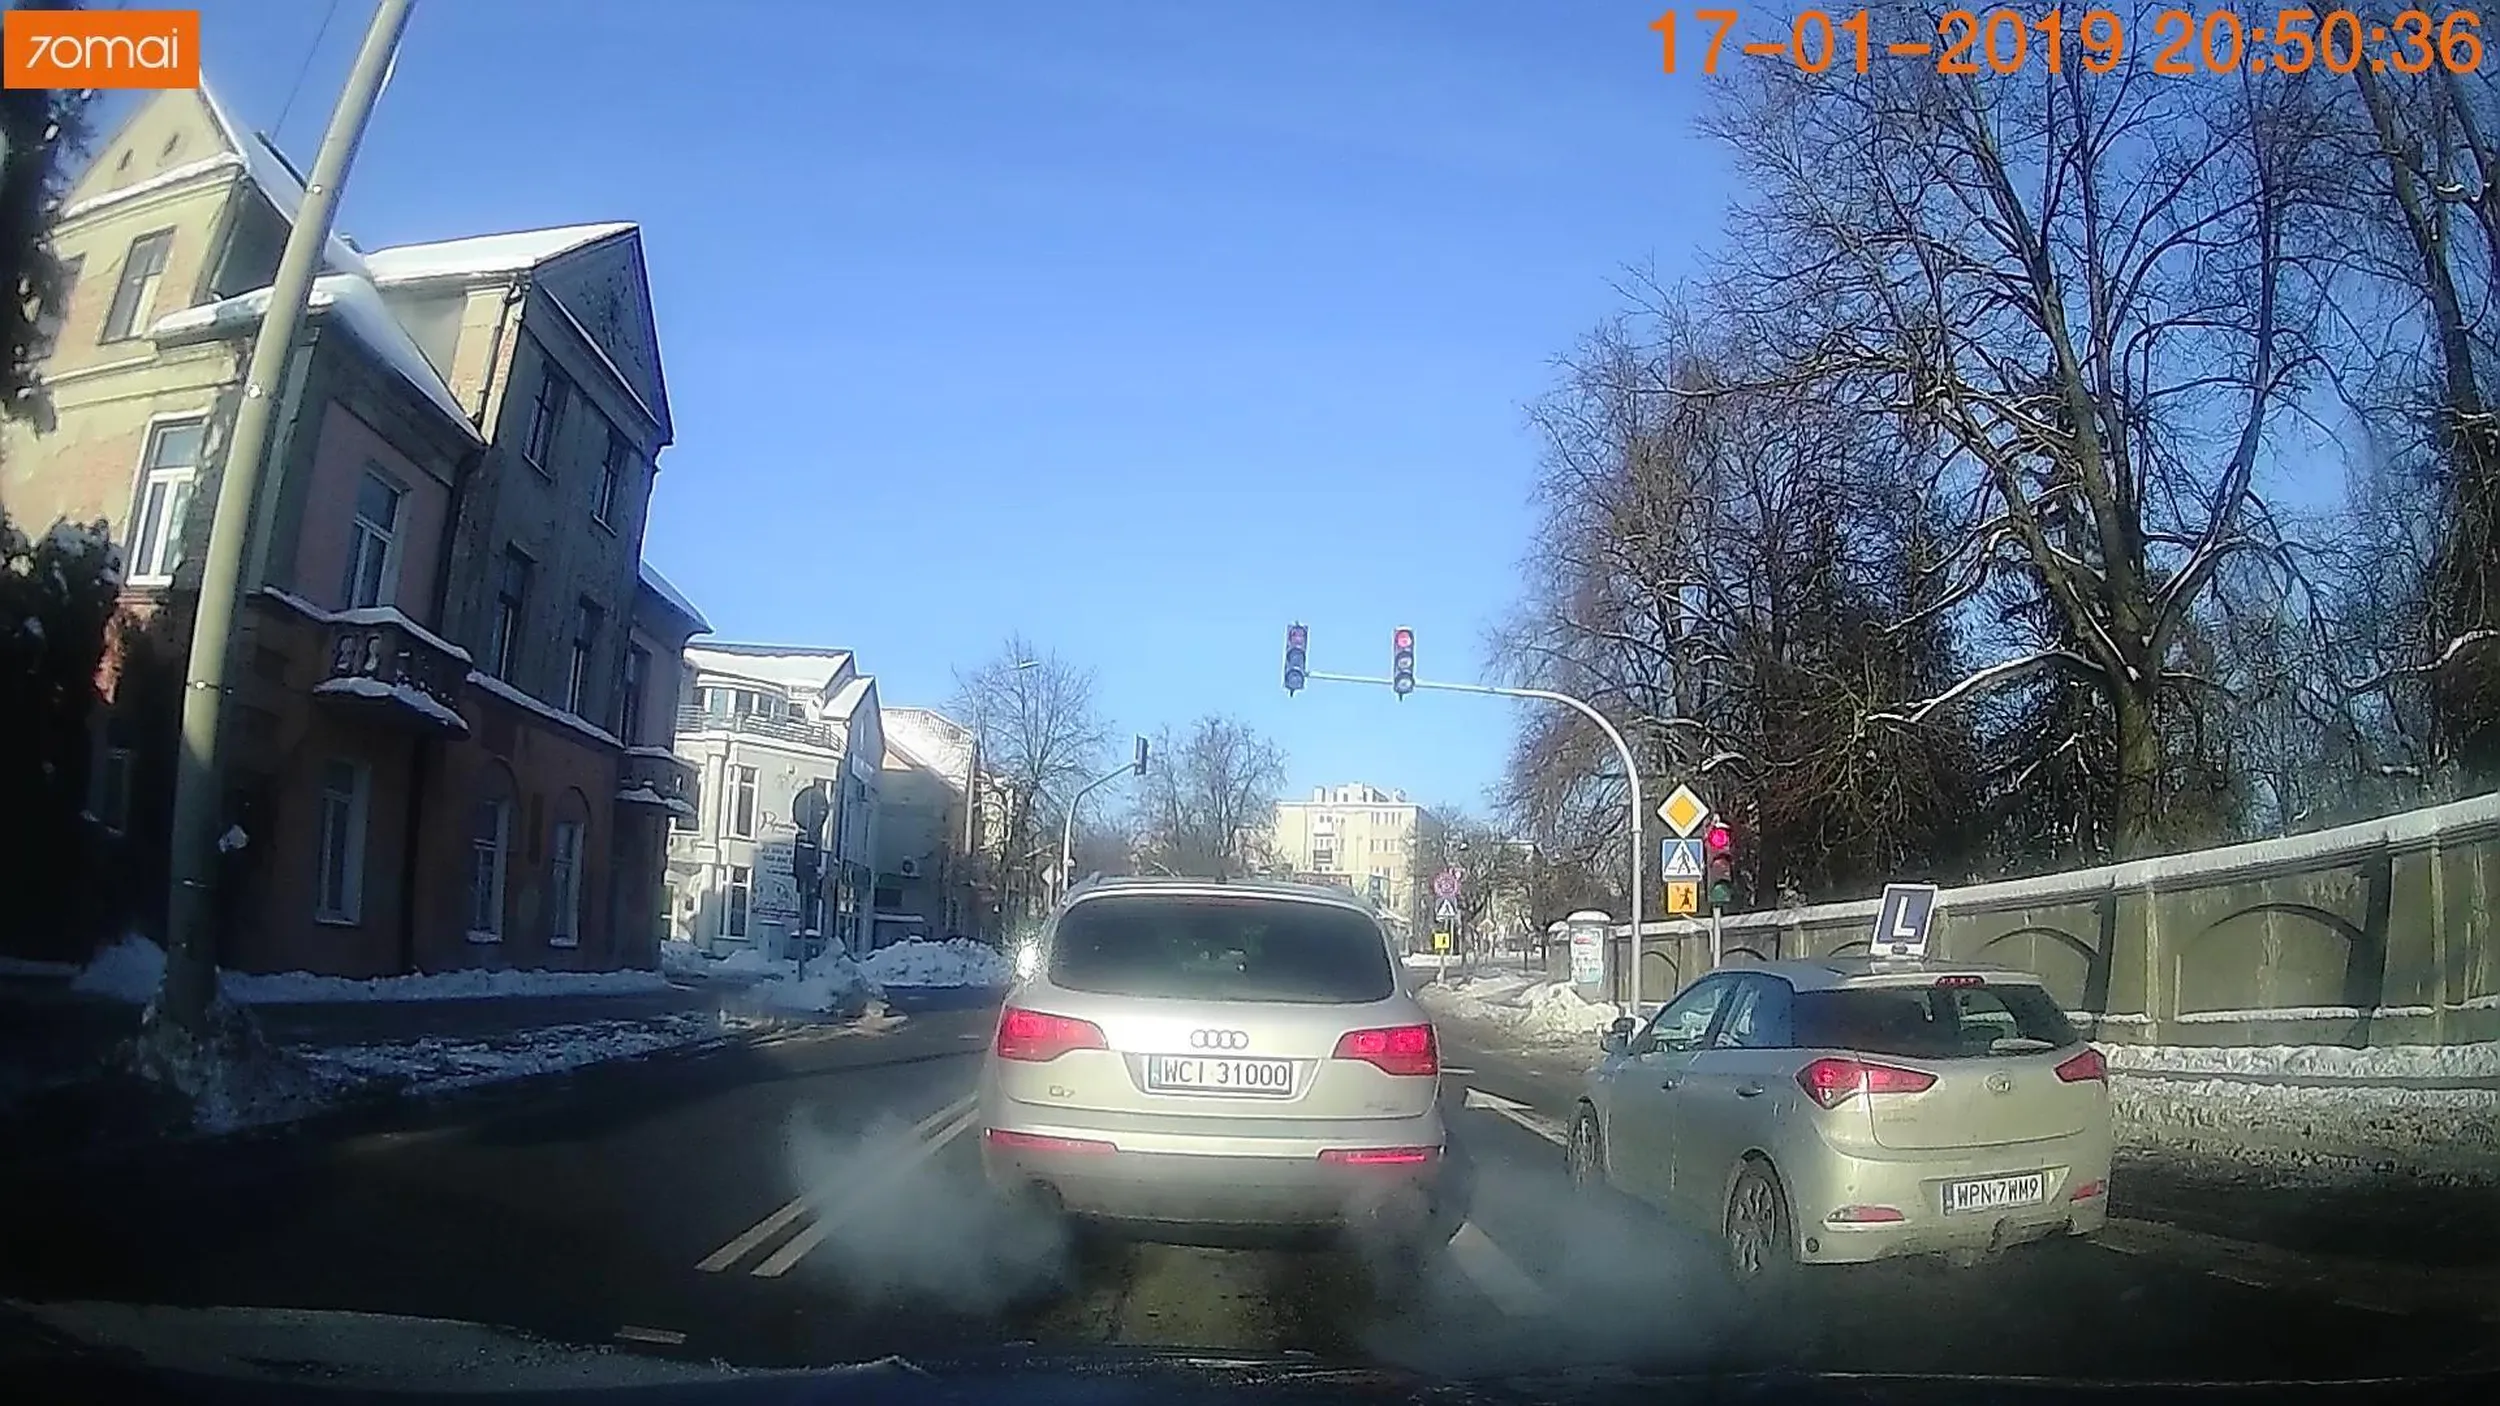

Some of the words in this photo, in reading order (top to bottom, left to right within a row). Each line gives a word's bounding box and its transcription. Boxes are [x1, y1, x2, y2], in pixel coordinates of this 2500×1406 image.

[1892, 896, 1917, 938] L
[1164, 1060, 1204, 1084] WCI
[1217, 1062, 1288, 1087] 31000
[1957, 1182, 1992, 1207] WPN
[1998, 1178, 2039, 1202] 7WM9
